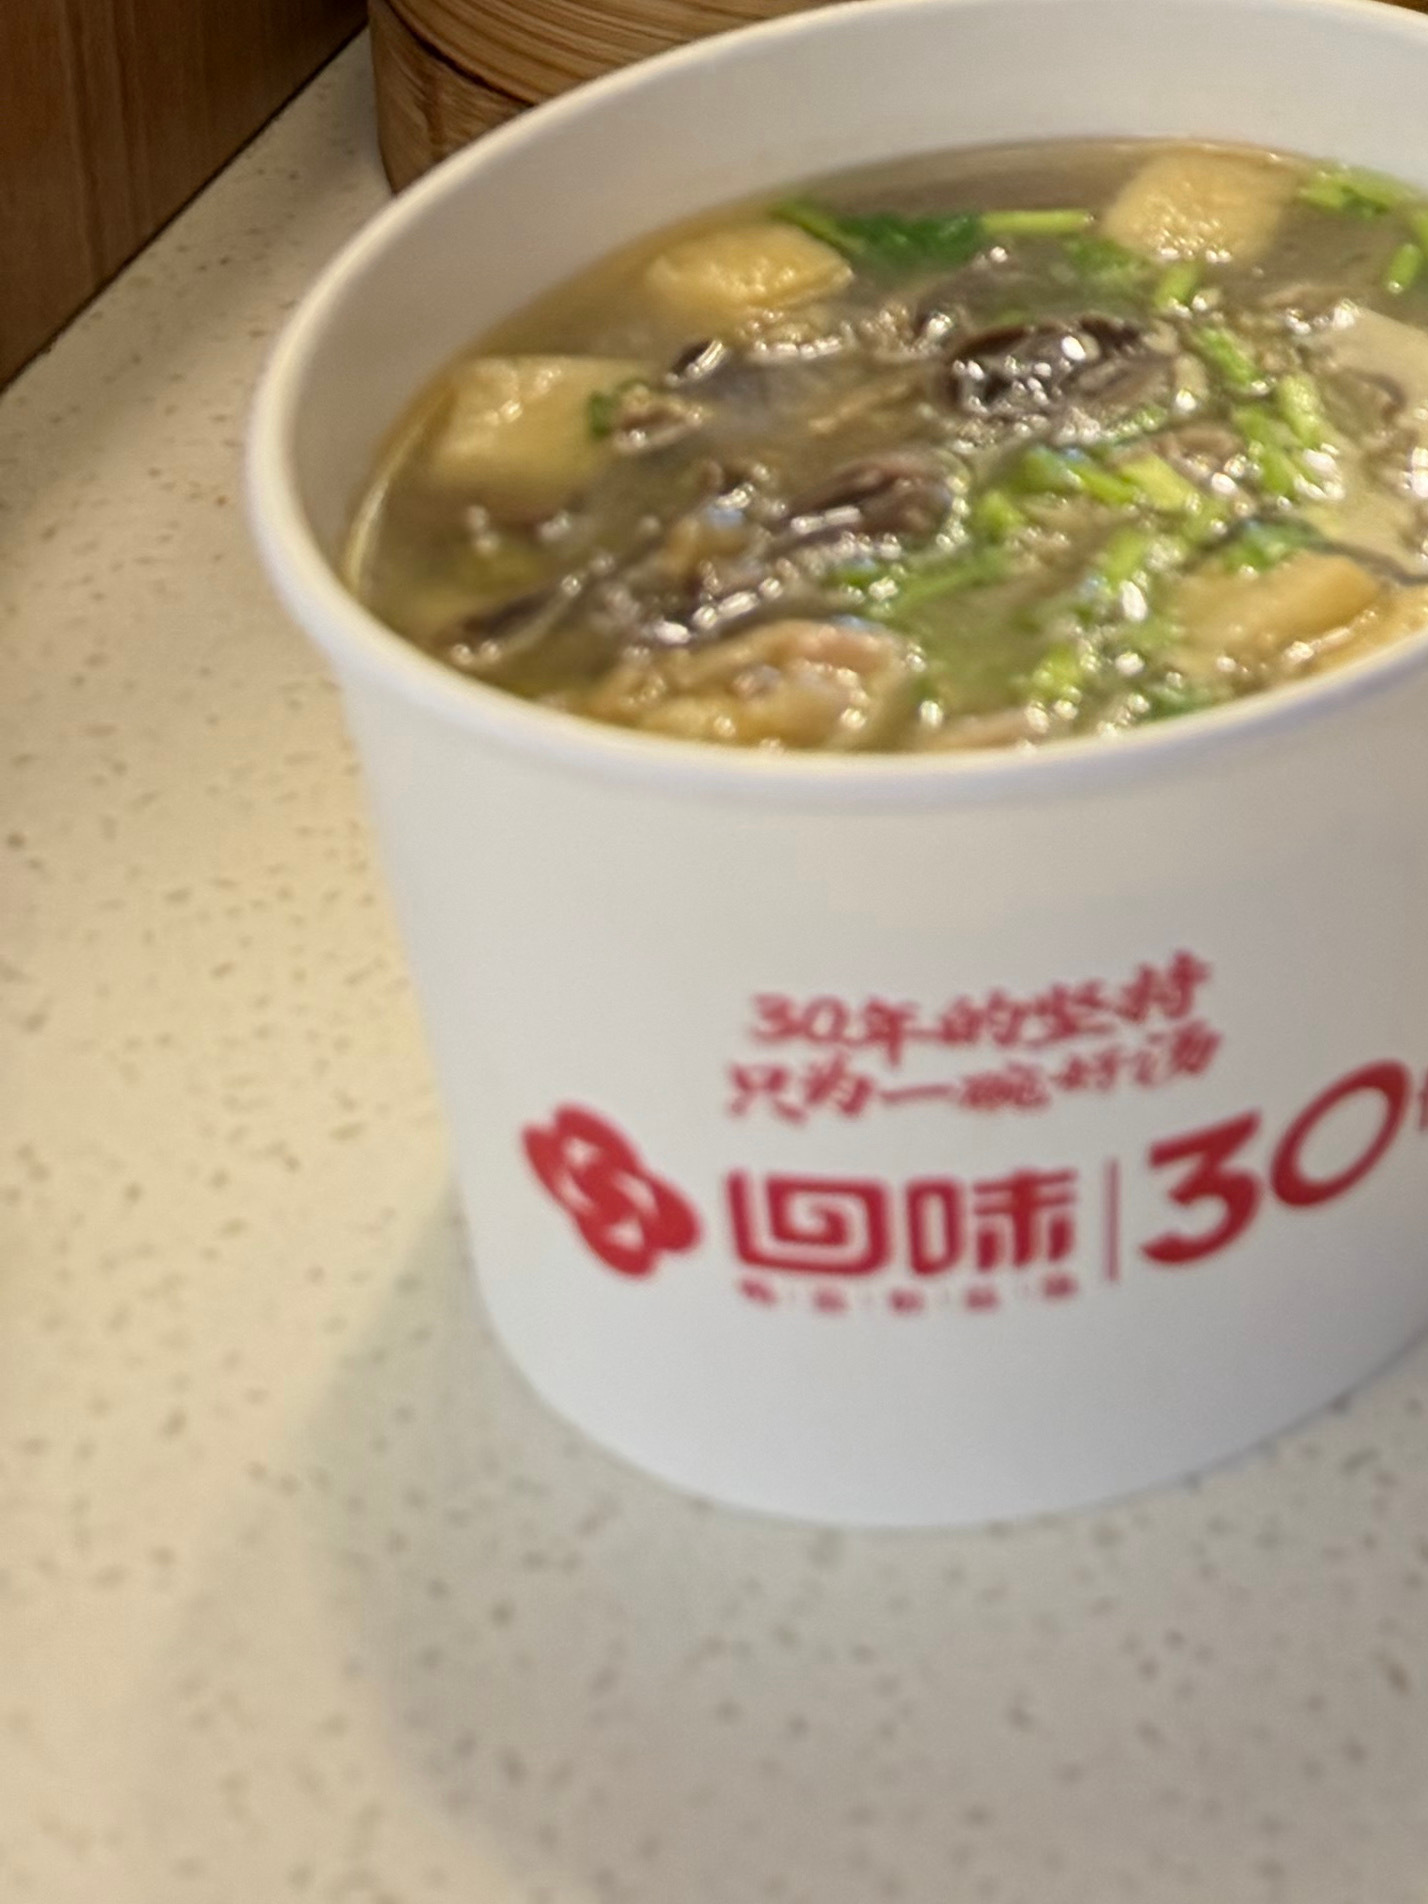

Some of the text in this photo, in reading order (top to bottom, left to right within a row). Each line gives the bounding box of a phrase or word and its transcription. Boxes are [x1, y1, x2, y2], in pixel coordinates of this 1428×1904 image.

[750, 949, 1212, 1071] 30年的坚持
[727, 1020, 1223, 1128] 只为一碗好汤
[724, 1166, 1079, 1280] 回味
